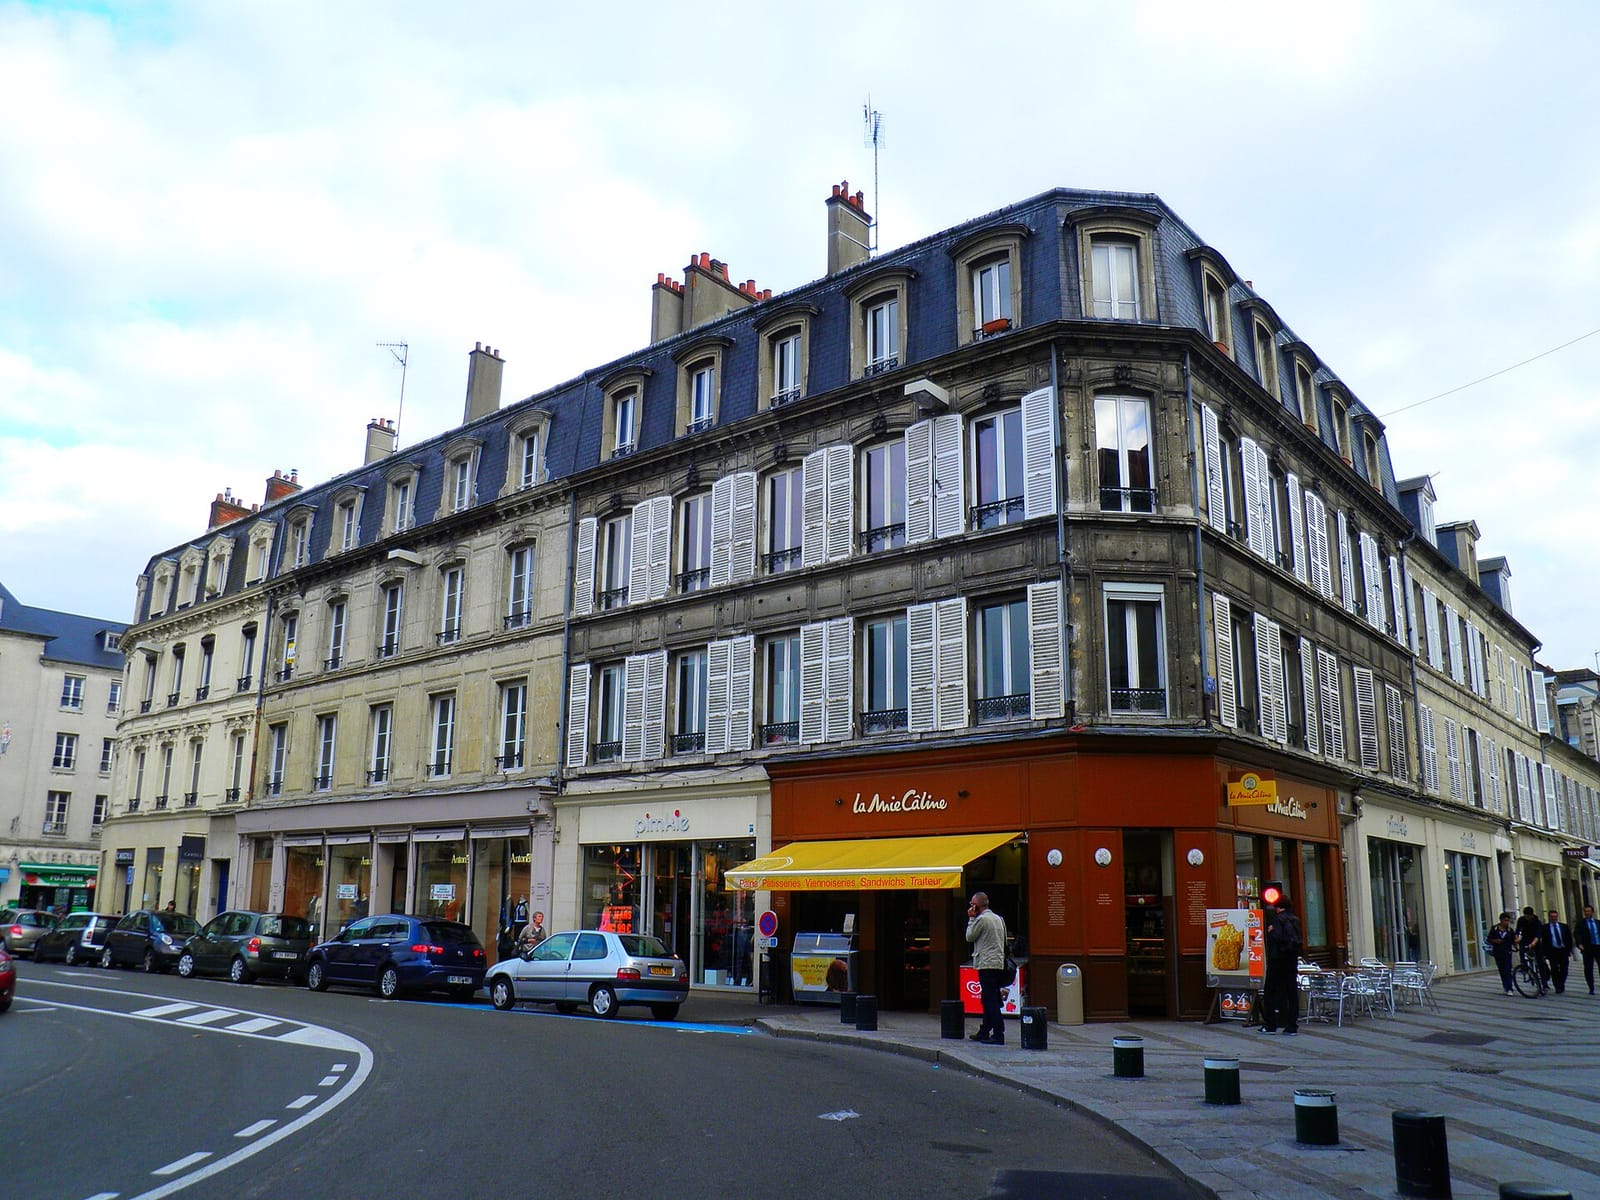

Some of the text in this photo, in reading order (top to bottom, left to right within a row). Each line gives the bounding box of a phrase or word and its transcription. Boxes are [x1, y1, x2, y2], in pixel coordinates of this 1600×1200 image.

[867, 793, 901, 813] Mie
[902, 789, 947, 811] Câline
[635, 809, 690, 838] pimkie
[805, 878, 856, 888] Viennoiseries
[860, 877, 906, 887] Sandwichs
[911, 876, 942, 886] Traiteur
